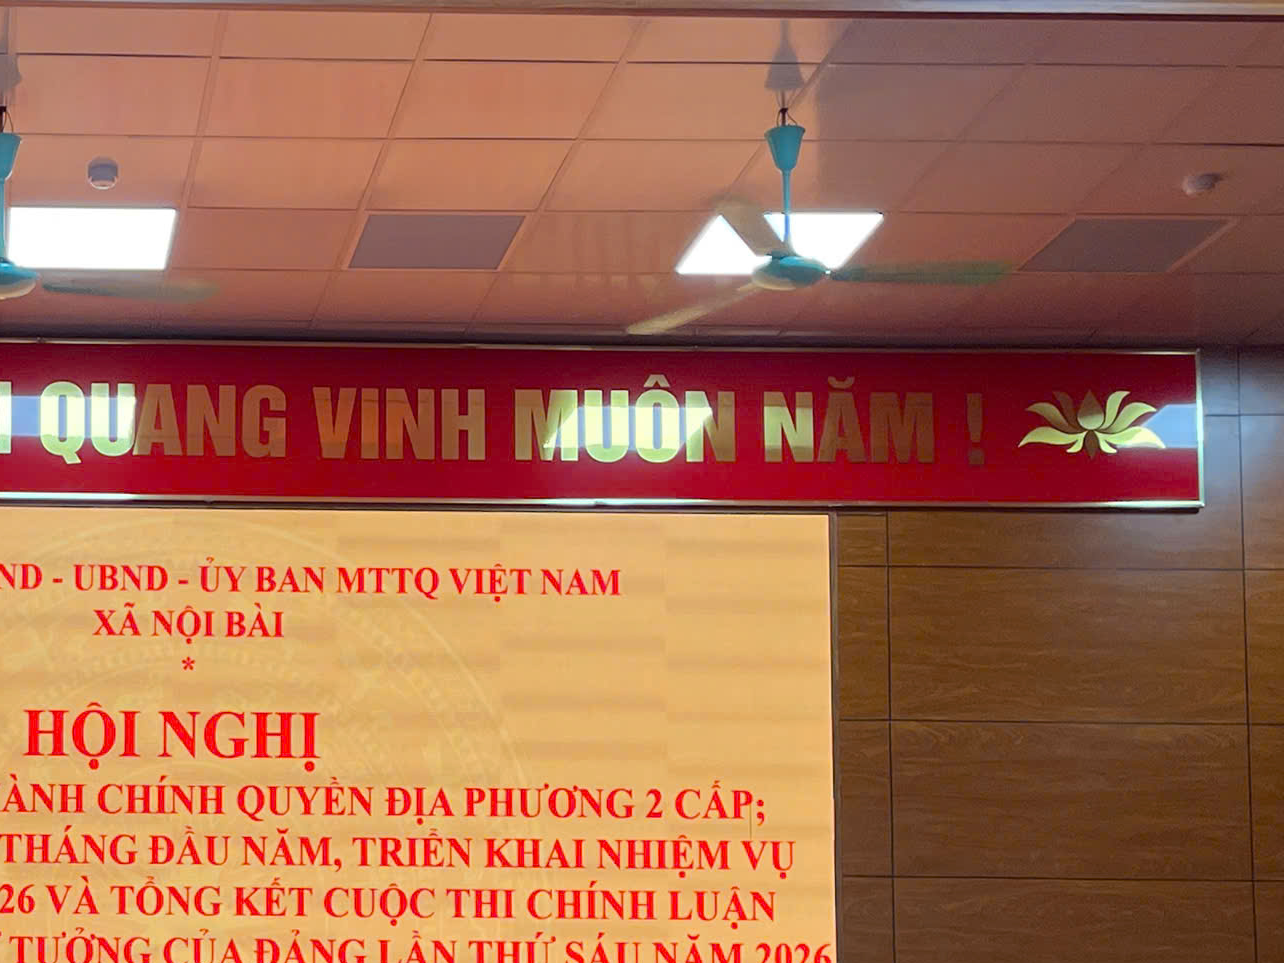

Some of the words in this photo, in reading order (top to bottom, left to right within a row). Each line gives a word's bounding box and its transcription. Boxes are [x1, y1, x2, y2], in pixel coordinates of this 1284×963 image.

[39, 381, 287, 465] QUANG
[313, 387, 485, 461] VINH
[515, 374, 736, 464] MUÔN
[762, 377, 935, 464] NĂM
[73, 564, 169, 592] UBND
[199, 557, 245, 593] ỦY
[255, 566, 325, 593] BAN
[337, 567, 440, 601] MTTQ
[448, 563, 532, 603] VIỆT
[541, 568, 621, 596] NAM
[93, 601, 141, 637] XÃ
[152, 605, 214, 645] NỘI
[225, 602, 284, 638] BÀI
[23, 701, 141, 770] HỘI
[157, 711, 320, 773] NGHỊ
[97, 775, 225, 815] CHÍNH
[236, 776, 373, 822] QUYỀN
[385, 786, 455, 825] ĐỊA
[464, 783, 634, 819] PHƯƠNG
[645, 788, 663, 819] 2
[674, 780, 765, 825] CẤP;
[148, 825, 230, 866] ĐẦU
[241, 828, 342, 872] NĂM,
[351, 832, 472, 868] TRIỂN
[483, 838, 585, 869] KHAI
[597, 834, 730, 879] NHIỆM
[741, 840, 795, 880] VỤ
[45, 875, 100, 915] VÀ
[110, 876, 221, 917] TỔNG
[235, 877, 313, 917] KẾT
[323, 883, 435, 927] CUỘC
[445, 888, 514, 919] THI
[526, 880, 656, 921] CHÍNH
[669, 886, 776, 930] LUẬN
